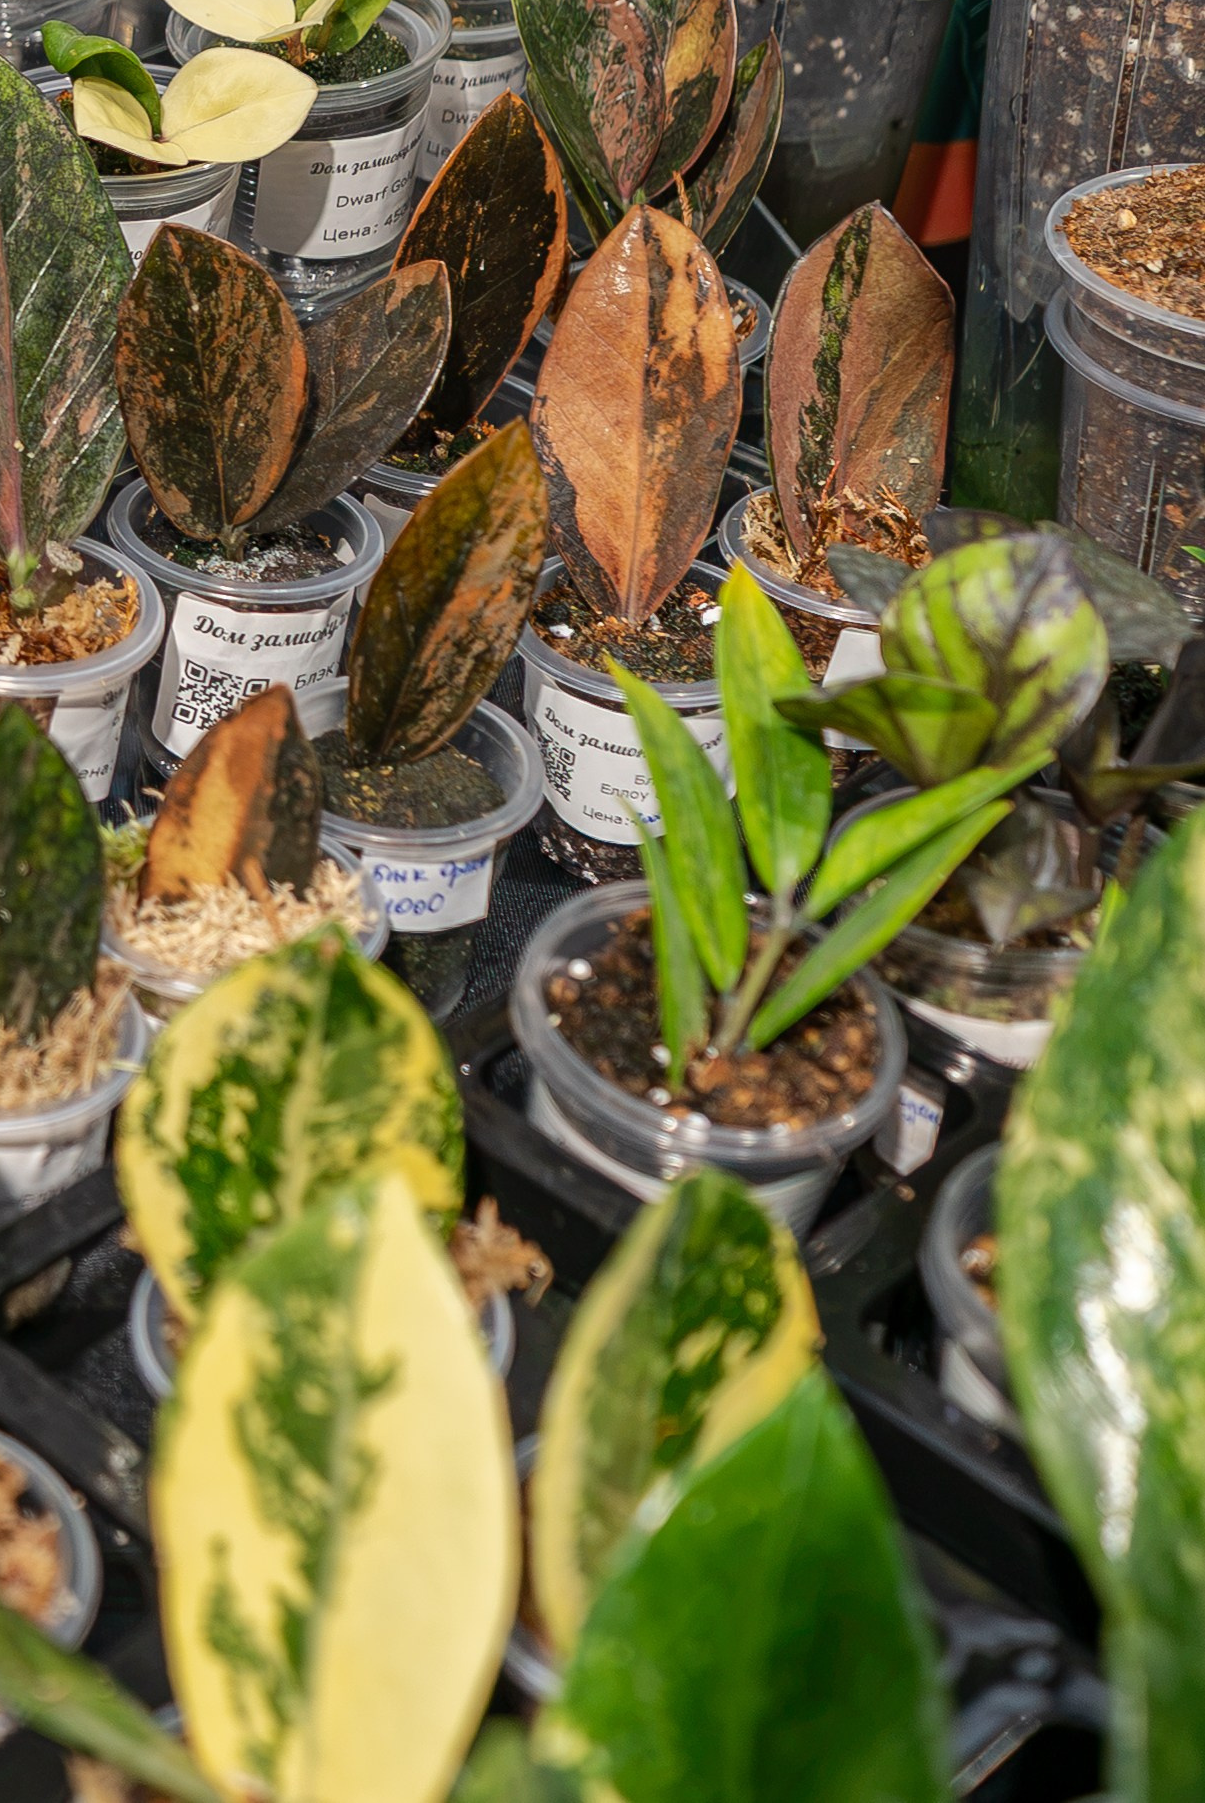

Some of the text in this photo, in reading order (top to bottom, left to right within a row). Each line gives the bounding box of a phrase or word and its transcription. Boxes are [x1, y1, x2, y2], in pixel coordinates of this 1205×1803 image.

[433, 74, 456, 86] ом
[442, 108, 478, 124] Dwa
[310, 161, 348, 175] Дом
[336, 186, 389, 208] Dwarf
[323, 223, 379, 243] Цена:
[193, 615, 247, 645] Дом
[294, 663, 335, 691] Блэк
[545, 706, 575, 739] Дом
[600, 782, 650, 802] Еллоу
